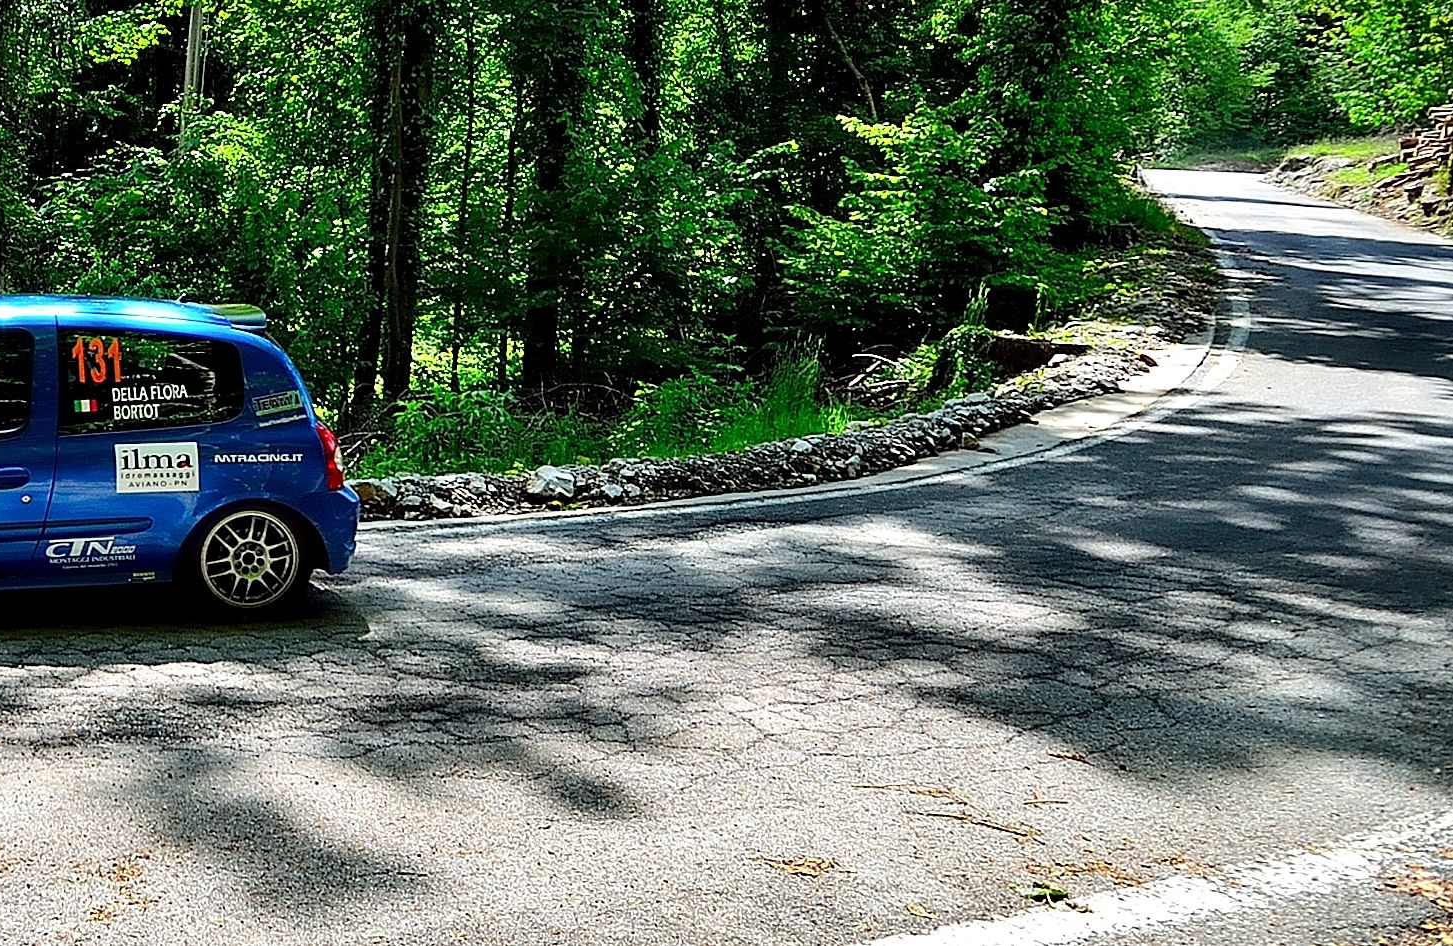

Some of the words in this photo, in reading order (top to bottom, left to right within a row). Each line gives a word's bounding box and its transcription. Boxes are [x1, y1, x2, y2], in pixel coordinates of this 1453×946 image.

[72, 335, 122, 383] 131
[111, 386, 148, 402] DELLA
[150, 384, 188, 401] FLORA
[113, 403, 160, 420] BORTOT
[120, 448, 194, 471] ilma
[214, 453, 304, 464] MTRACING.IT
[121, 471, 195, 480] idromassaggi
[49, 556, 89, 564] MONTAGGI
[91, 554, 136, 563] INDUSTRIALI
